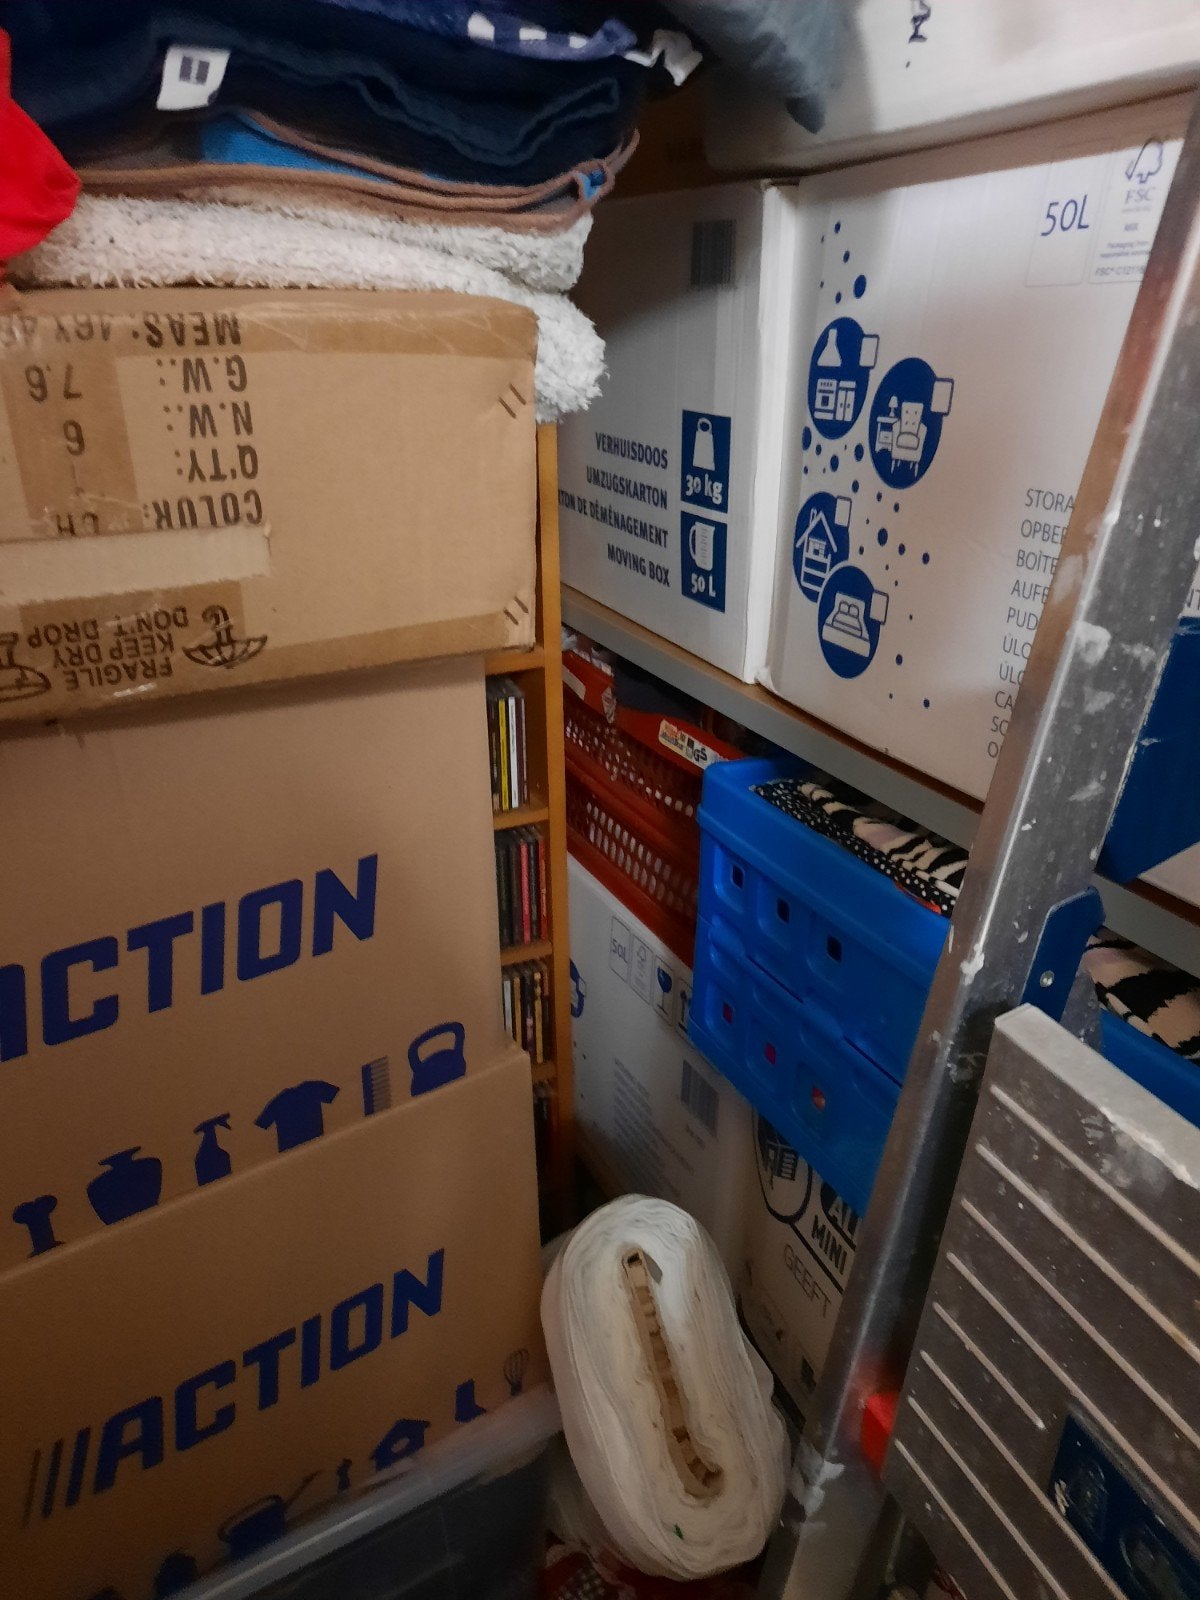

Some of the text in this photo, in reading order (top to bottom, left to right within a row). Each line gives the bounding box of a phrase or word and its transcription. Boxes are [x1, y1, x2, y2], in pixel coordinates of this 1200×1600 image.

[1041, 194, 1089, 236] 50L
[156, 354, 248, 393] G.W.:
[63, 401, 254, 456] N.W.: 6
[595, 432, 668, 469] VERHUISDOOS
[586, 465, 668, 510] UMZUGSKARTON
[685, 473, 723, 505] 30 kg
[577, 496, 588, 516] DE
[589, 499, 669, 549] DÉMÉNAGEMENT
[607, 543, 670, 588] MOVING BOX
[691, 573, 717, 598] 50 L
[27, 619, 101, 649] DROP
[53, 632, 175, 669] KEEP DRY
[63, 657, 173, 691] FRAGILE
[811, 1214, 848, 1275] MINI
[94, 1248, 445, 1495] ACTION
